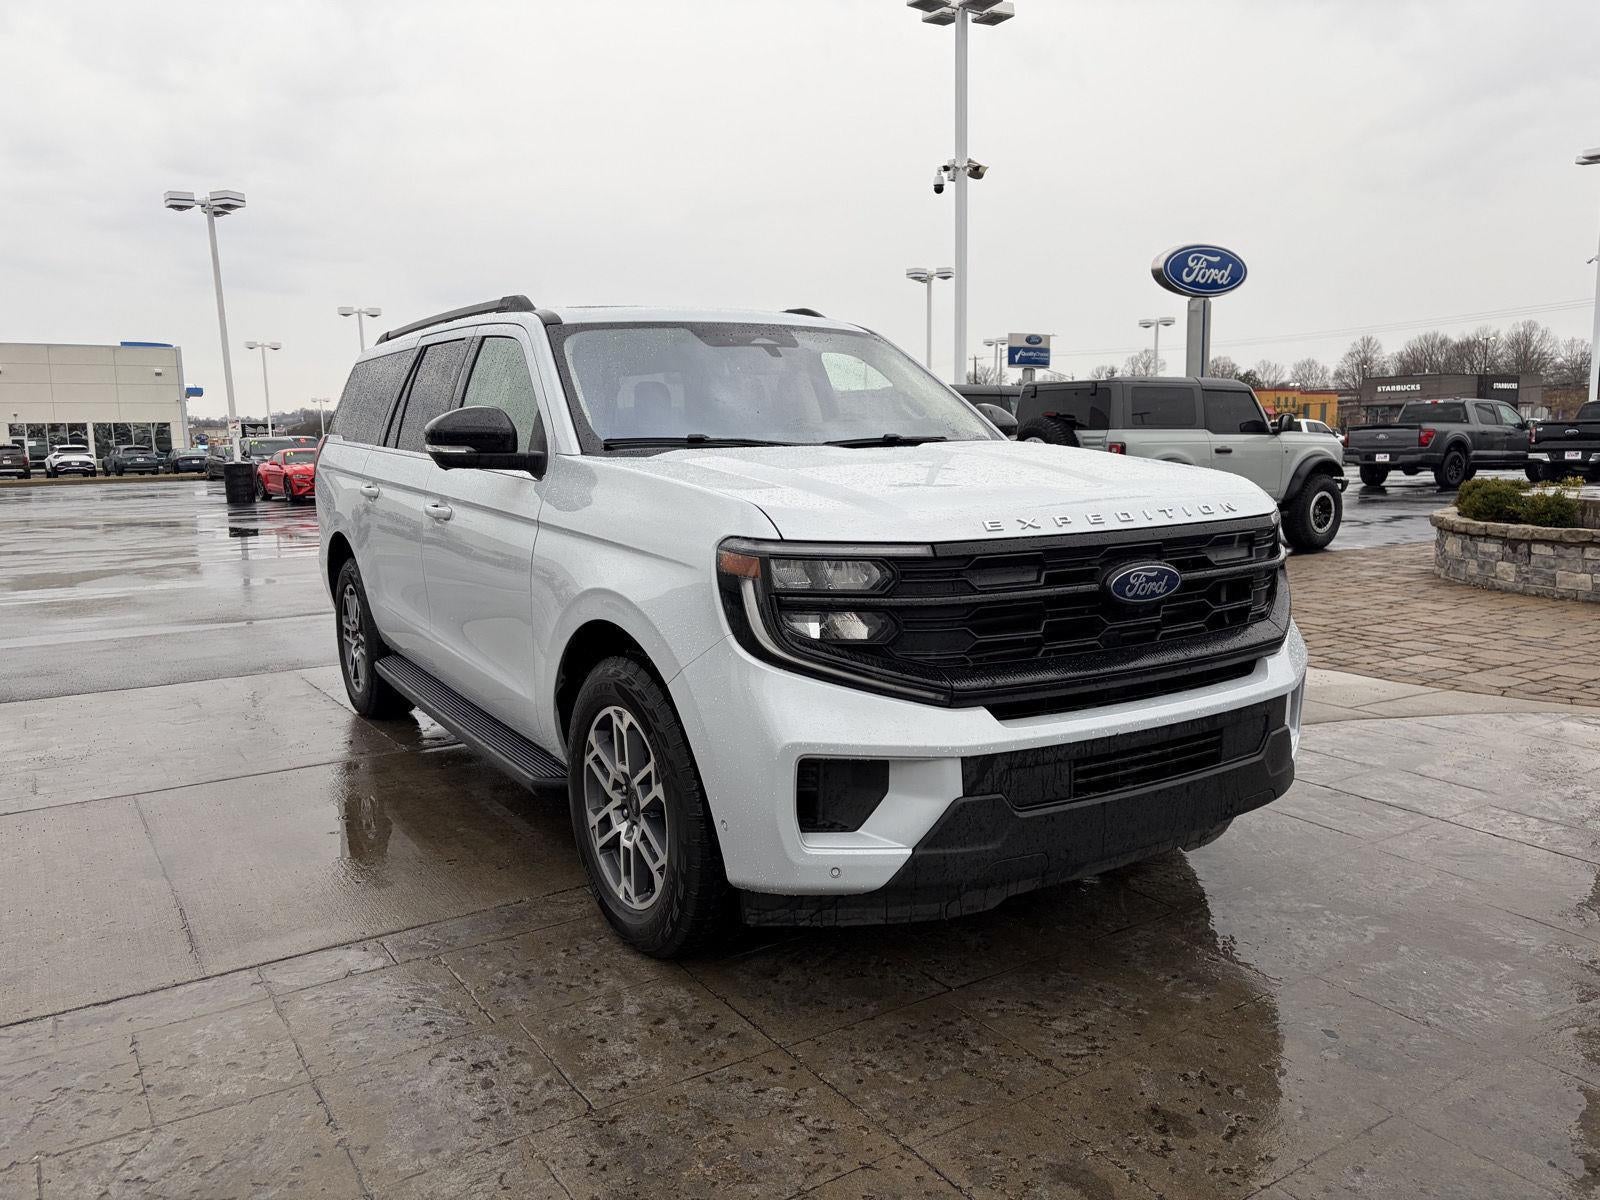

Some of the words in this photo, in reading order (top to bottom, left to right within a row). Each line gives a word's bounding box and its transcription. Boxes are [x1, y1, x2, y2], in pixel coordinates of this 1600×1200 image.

[1182, 253, 1232, 284] Ford
[1377, 384, 1421, 392] STARBUCKS
[982, 502, 1238, 531] EXPEDITION
[1125, 571, 1168, 596] Ford
